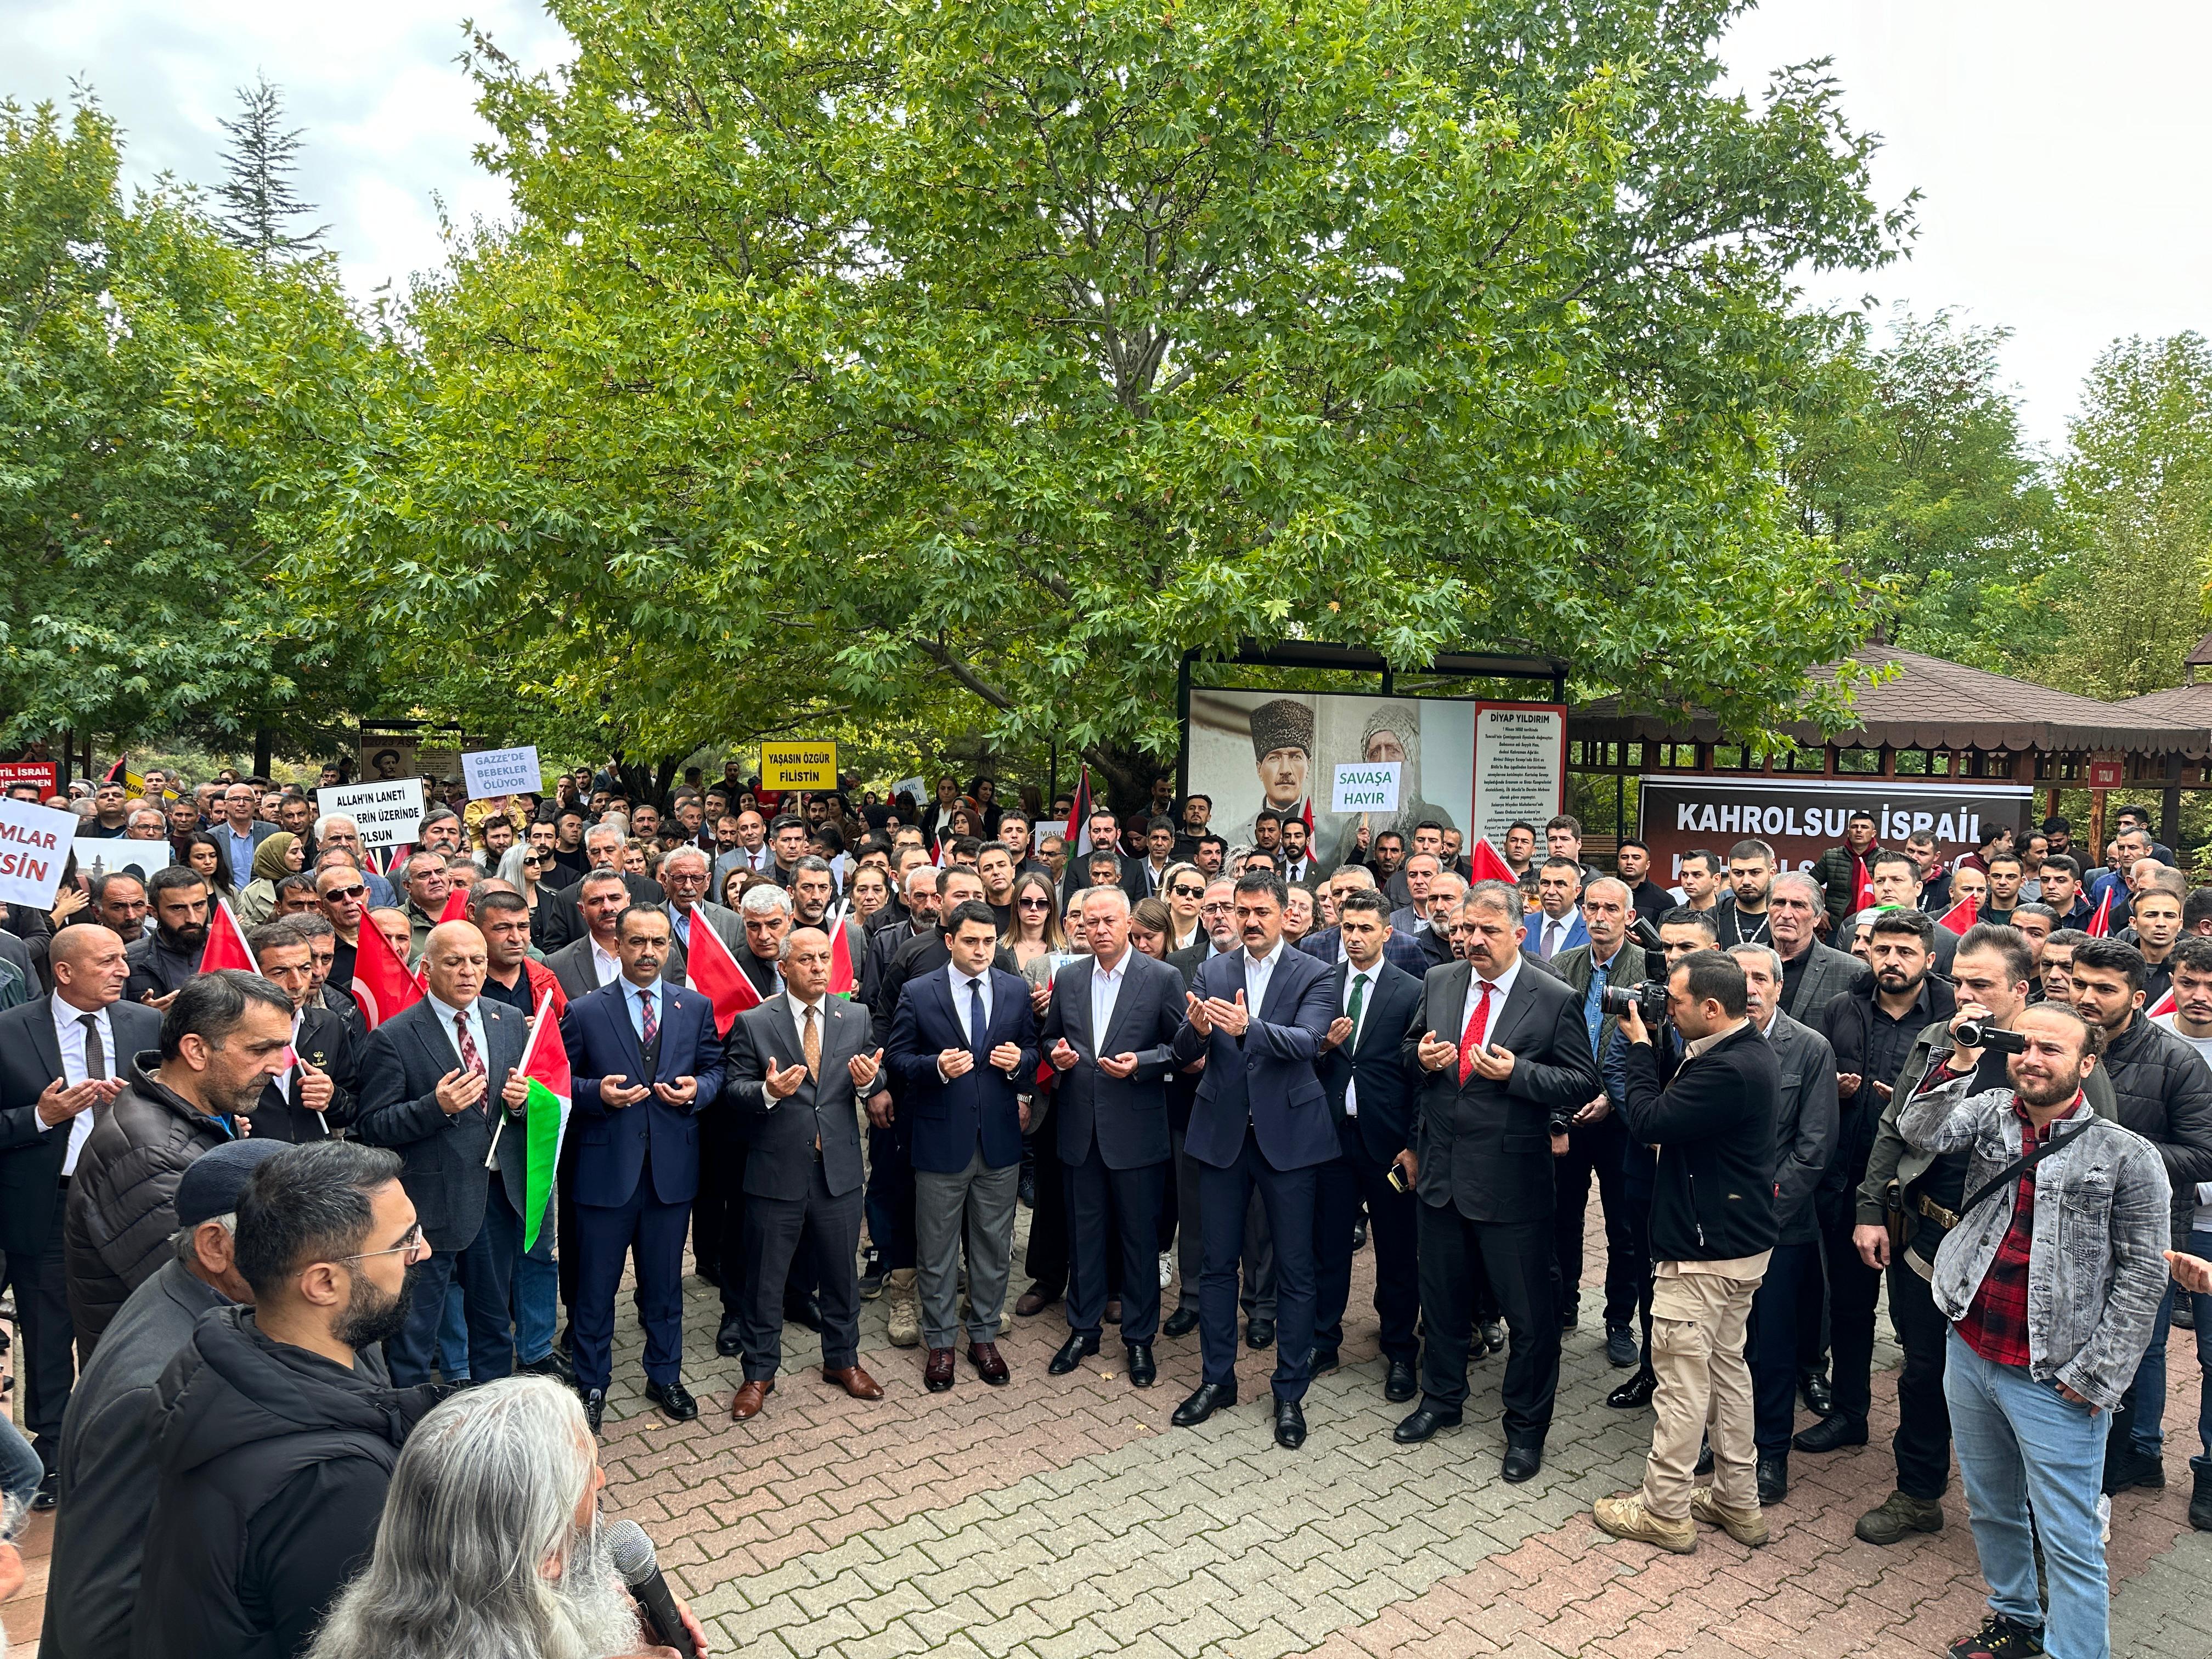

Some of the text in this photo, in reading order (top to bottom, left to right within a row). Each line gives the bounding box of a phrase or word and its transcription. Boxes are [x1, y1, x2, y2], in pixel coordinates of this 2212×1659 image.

[1491, 712, 1550, 724] DİYAP YILDIRIM
[475, 753, 525, 765] GAZZE'DE
[769, 752, 830, 766] YAŞASIN ÖZGÜR
[18, 766, 52, 776] İSRAİL
[477, 765, 527, 778] BEBEKLER
[780, 769, 820, 782] FİLİSTİN
[483, 778, 526, 789] ÖLÜYOR
[1339, 771, 1392, 786] SAVAŞA
[900, 782, 917, 791] KATİL
[337, 786, 405, 807] ALLAH'IN LANETİ
[1344, 792, 1385, 804] HAYIR
[379, 806, 420, 821] ÜZERİNDE
[1677, 803, 1869, 837] KAHROLSU
[0, 852, 48, 881] SİN
